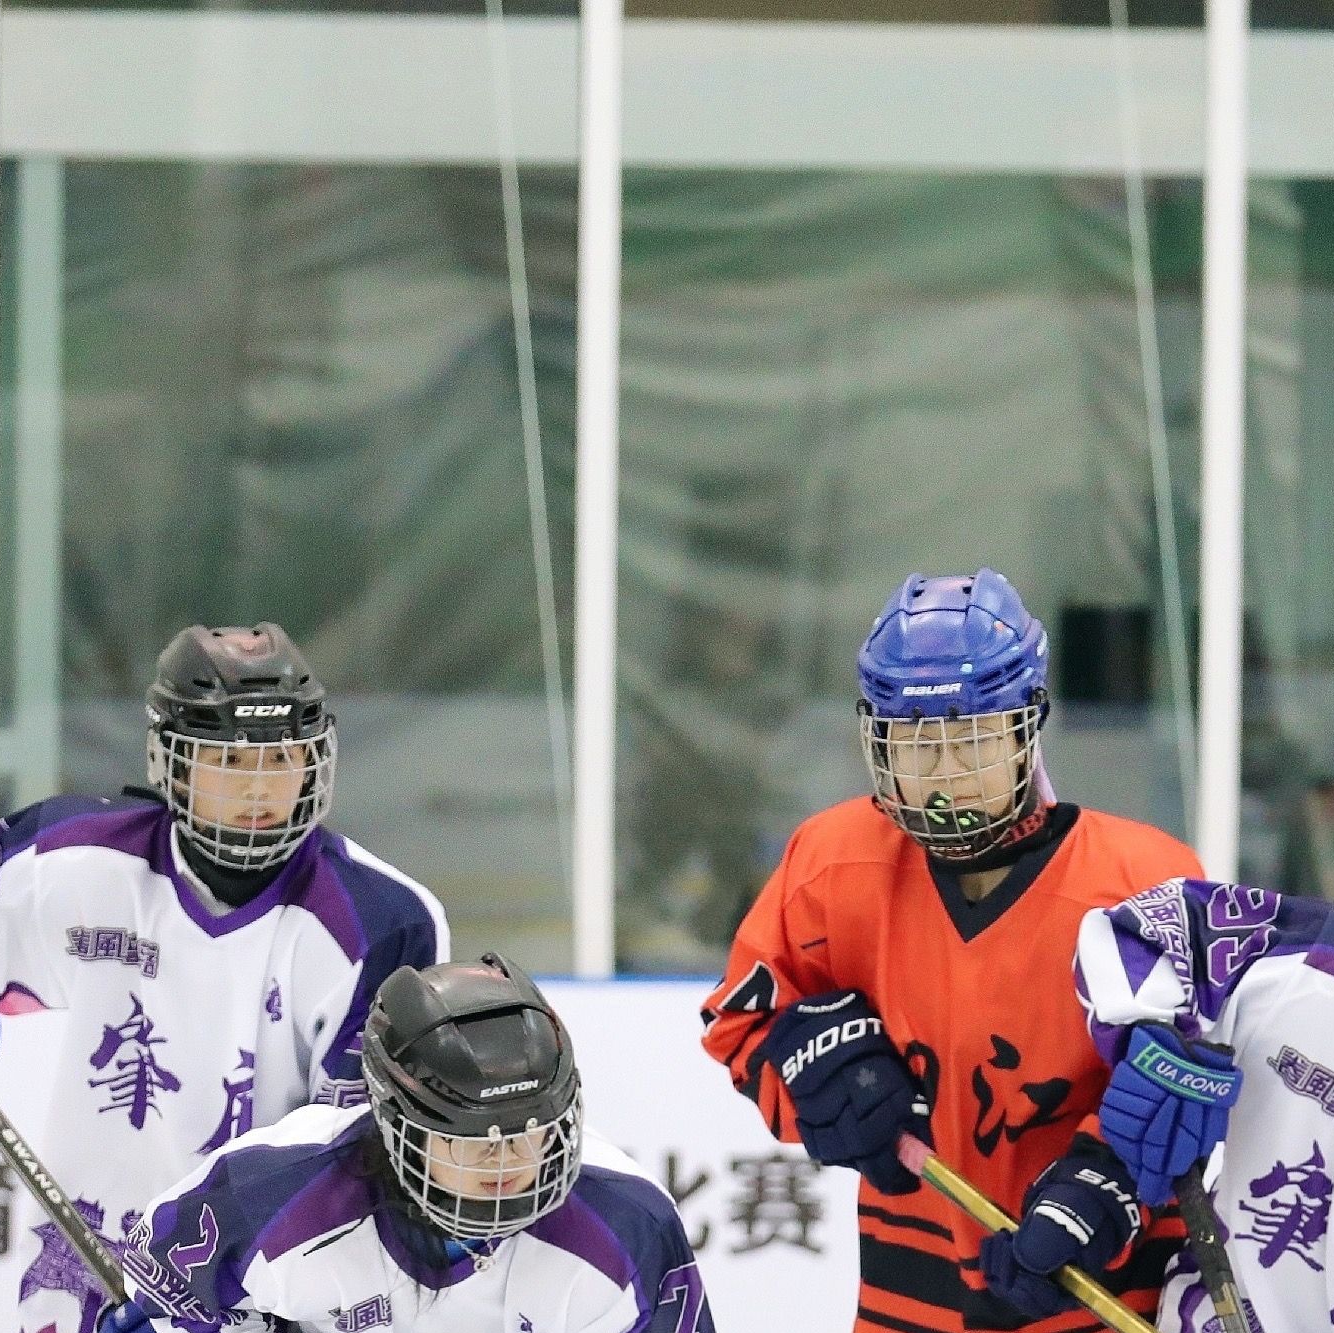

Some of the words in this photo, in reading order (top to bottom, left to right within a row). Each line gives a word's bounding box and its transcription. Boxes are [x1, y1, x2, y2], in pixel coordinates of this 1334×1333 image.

[233, 703, 292, 718] CCM
[480, 1079, 540, 1099] EASTON
[1178, 1070, 1233, 1097] RONG
